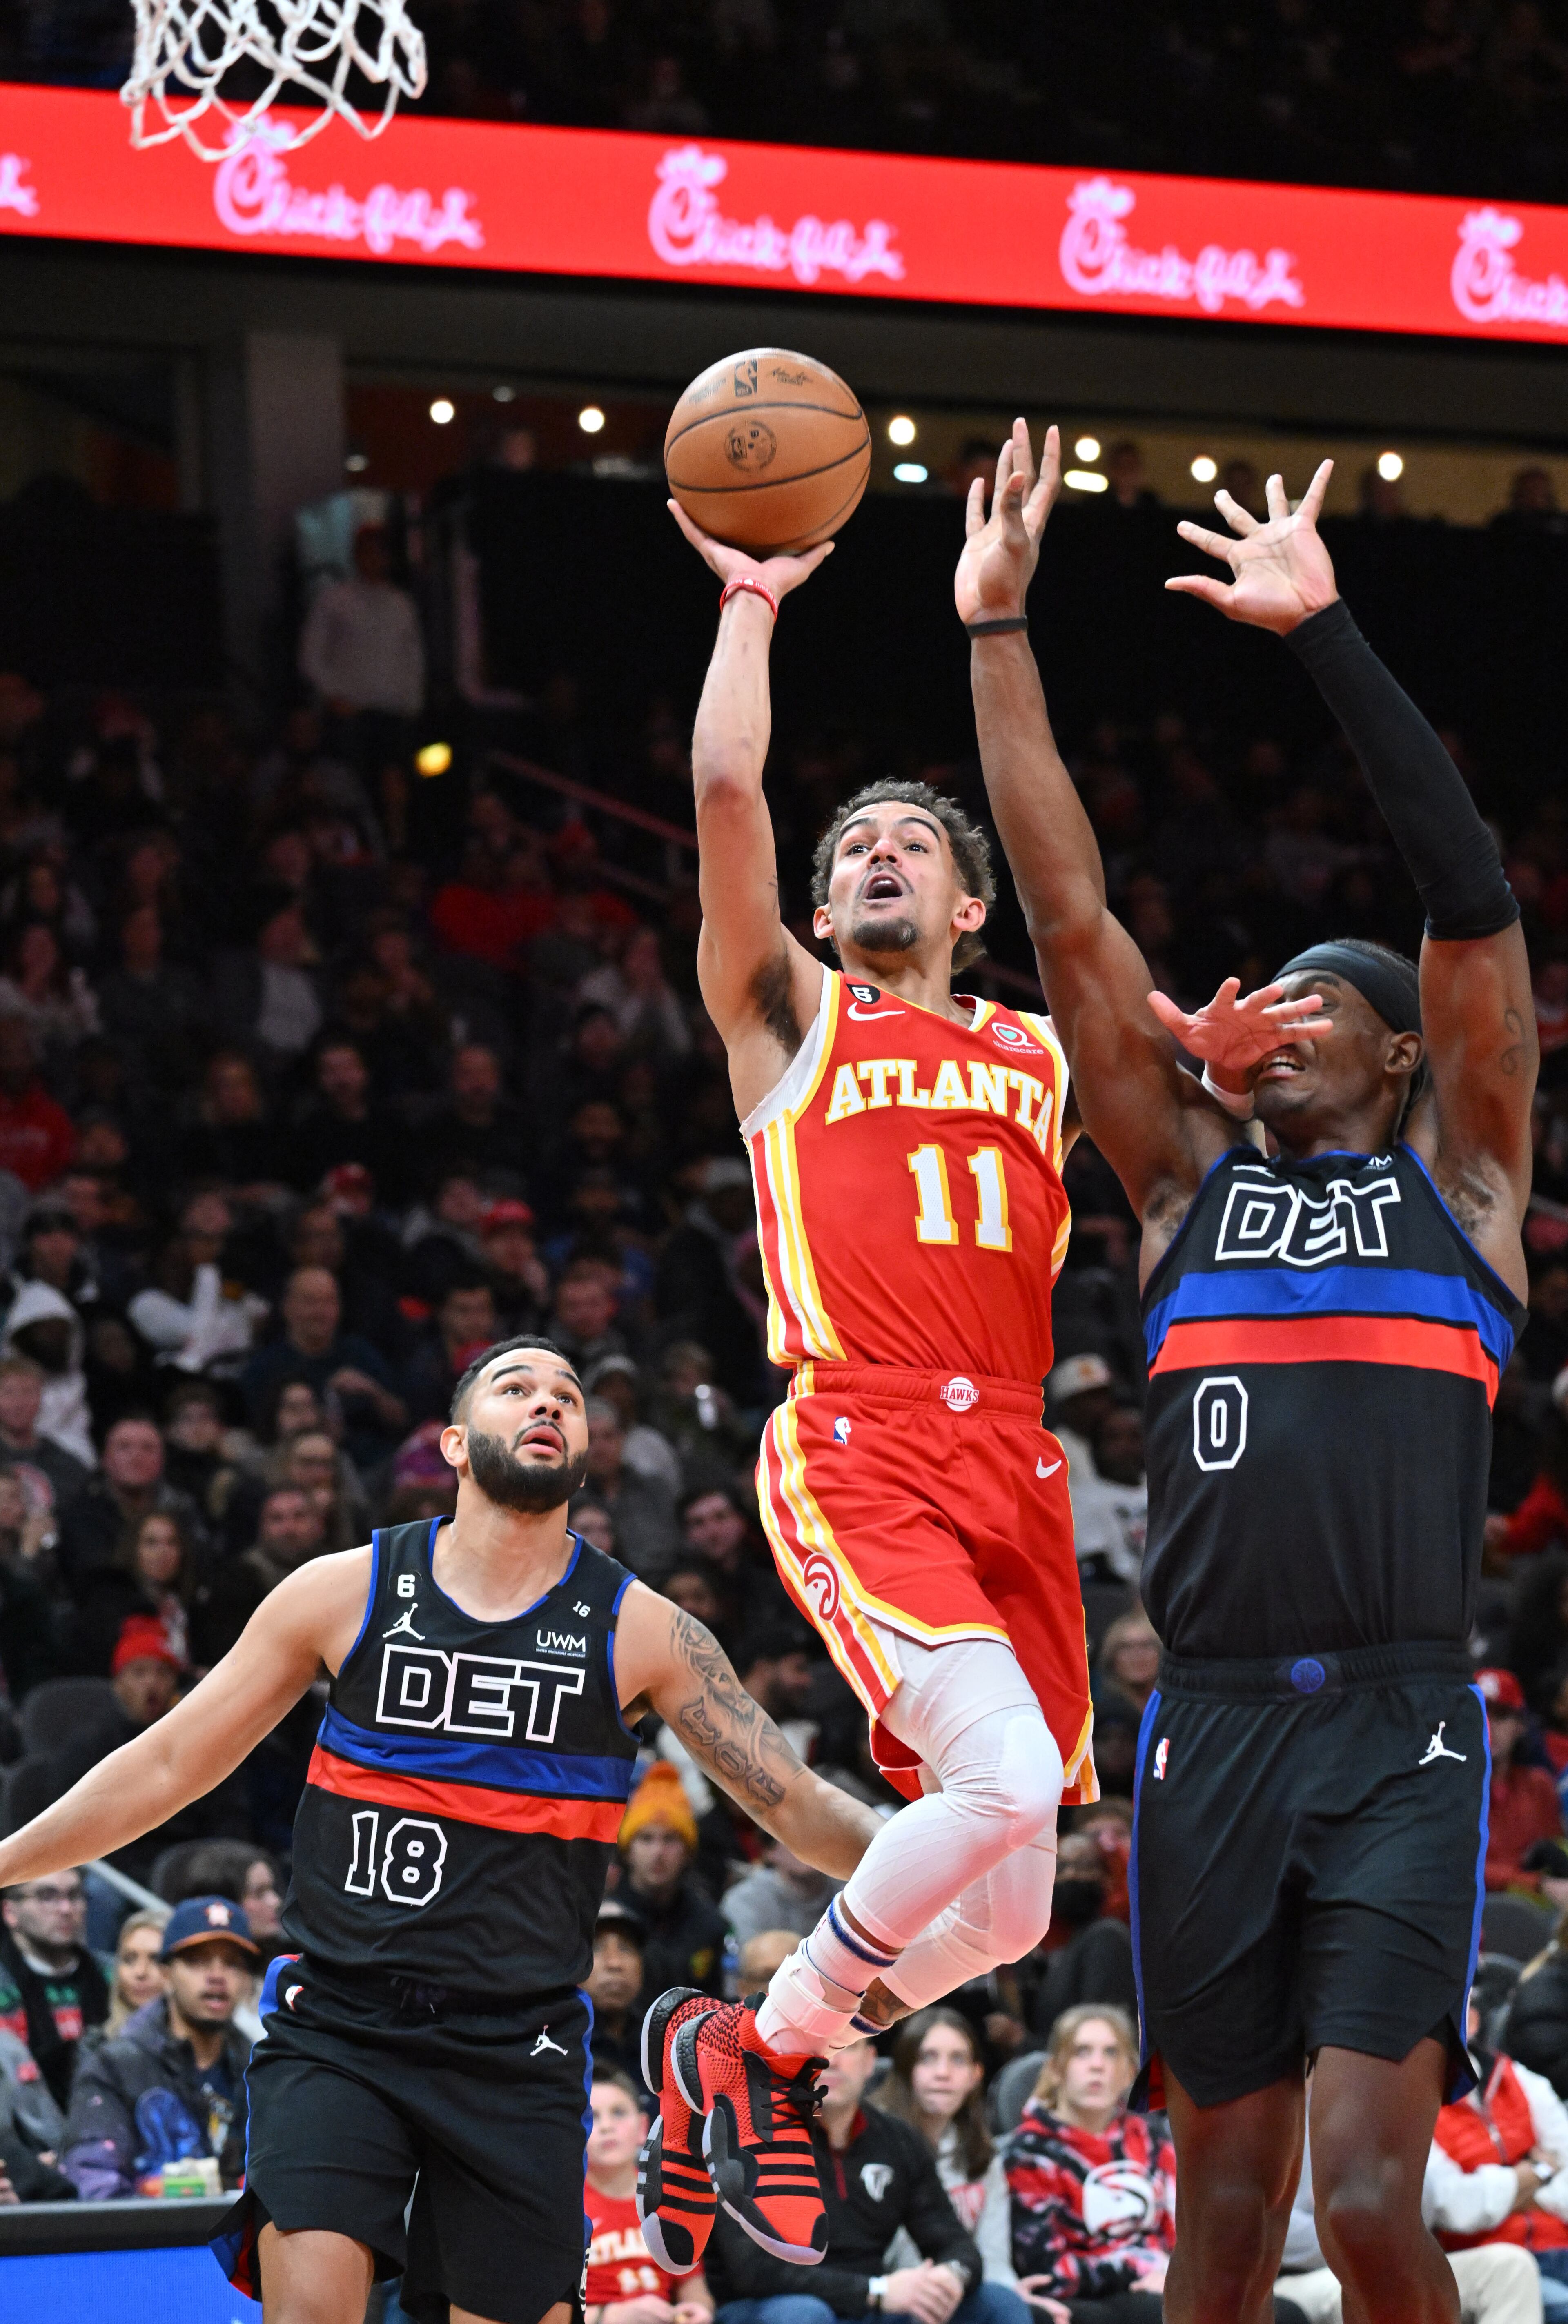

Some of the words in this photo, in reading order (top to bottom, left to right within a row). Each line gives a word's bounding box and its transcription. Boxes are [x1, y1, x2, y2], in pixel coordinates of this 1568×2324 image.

[852, 987, 872, 1002] 6
[993, 1040, 1044, 1054] sharecare
[825, 1058, 1054, 1155] ATLANTA
[907, 1144, 1012, 1252] 11
[1215, 1177, 1401, 1266] DET
[940, 1387, 978, 1402] HAWKS
[1193, 1376, 1248, 1471] 0
[397, 1574, 415, 1597] 6
[573, 1601, 591, 1617] 16
[537, 1629, 586, 1652] UWM
[376, 1643, 585, 1743] DET
[344, 1810, 448, 1906] 18
